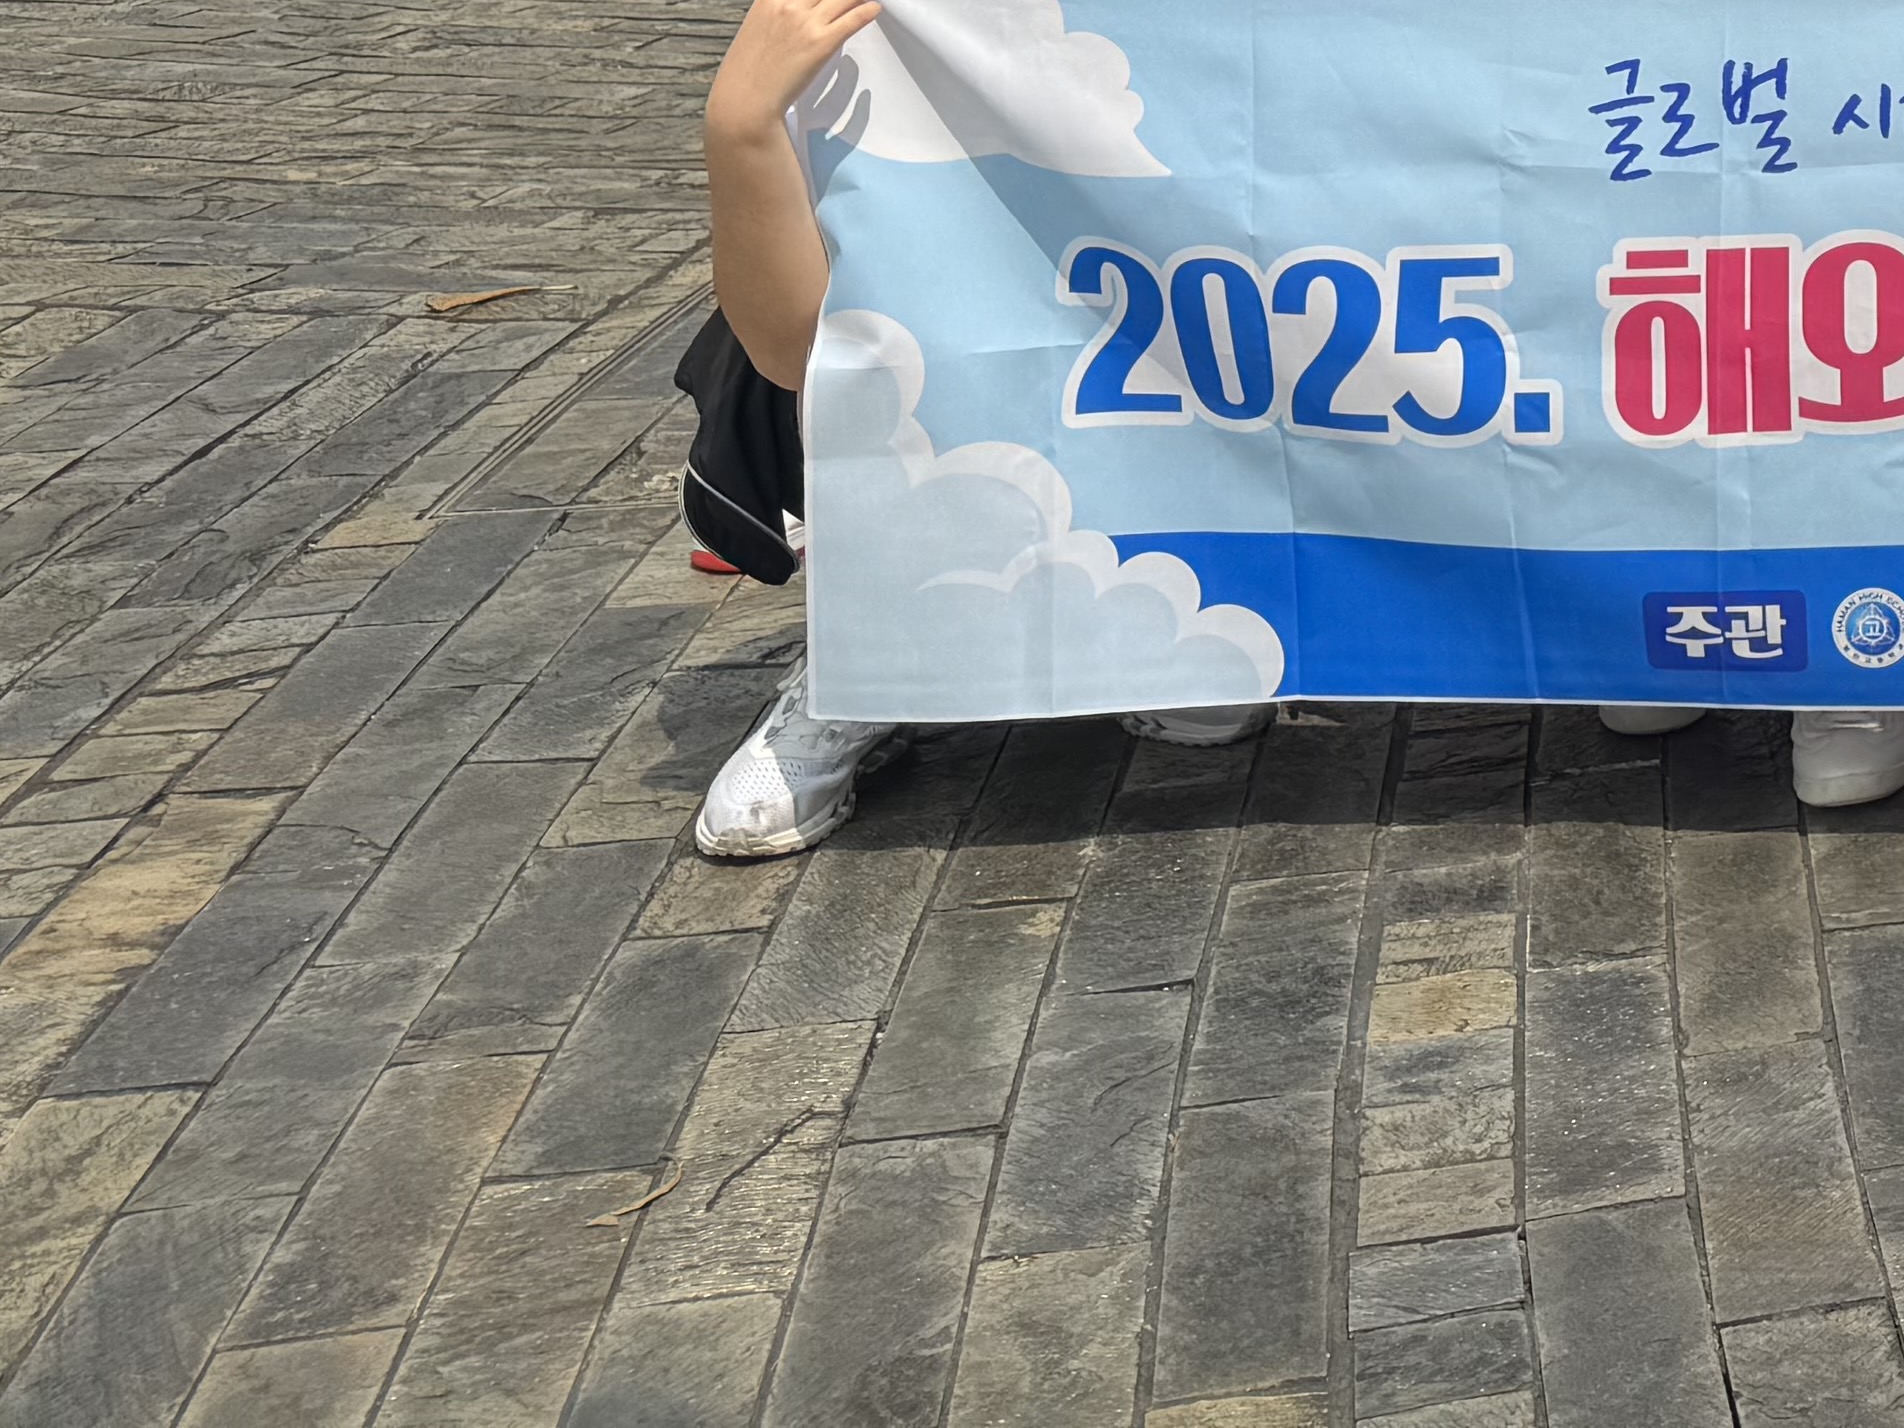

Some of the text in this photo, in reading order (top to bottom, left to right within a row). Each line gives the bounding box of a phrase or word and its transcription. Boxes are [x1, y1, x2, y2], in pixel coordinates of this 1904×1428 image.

[1592, 59, 1794, 182] 글로벌
[1066, 246, 1552, 436] 2025.
[1665, 604, 1787, 659] 주관
